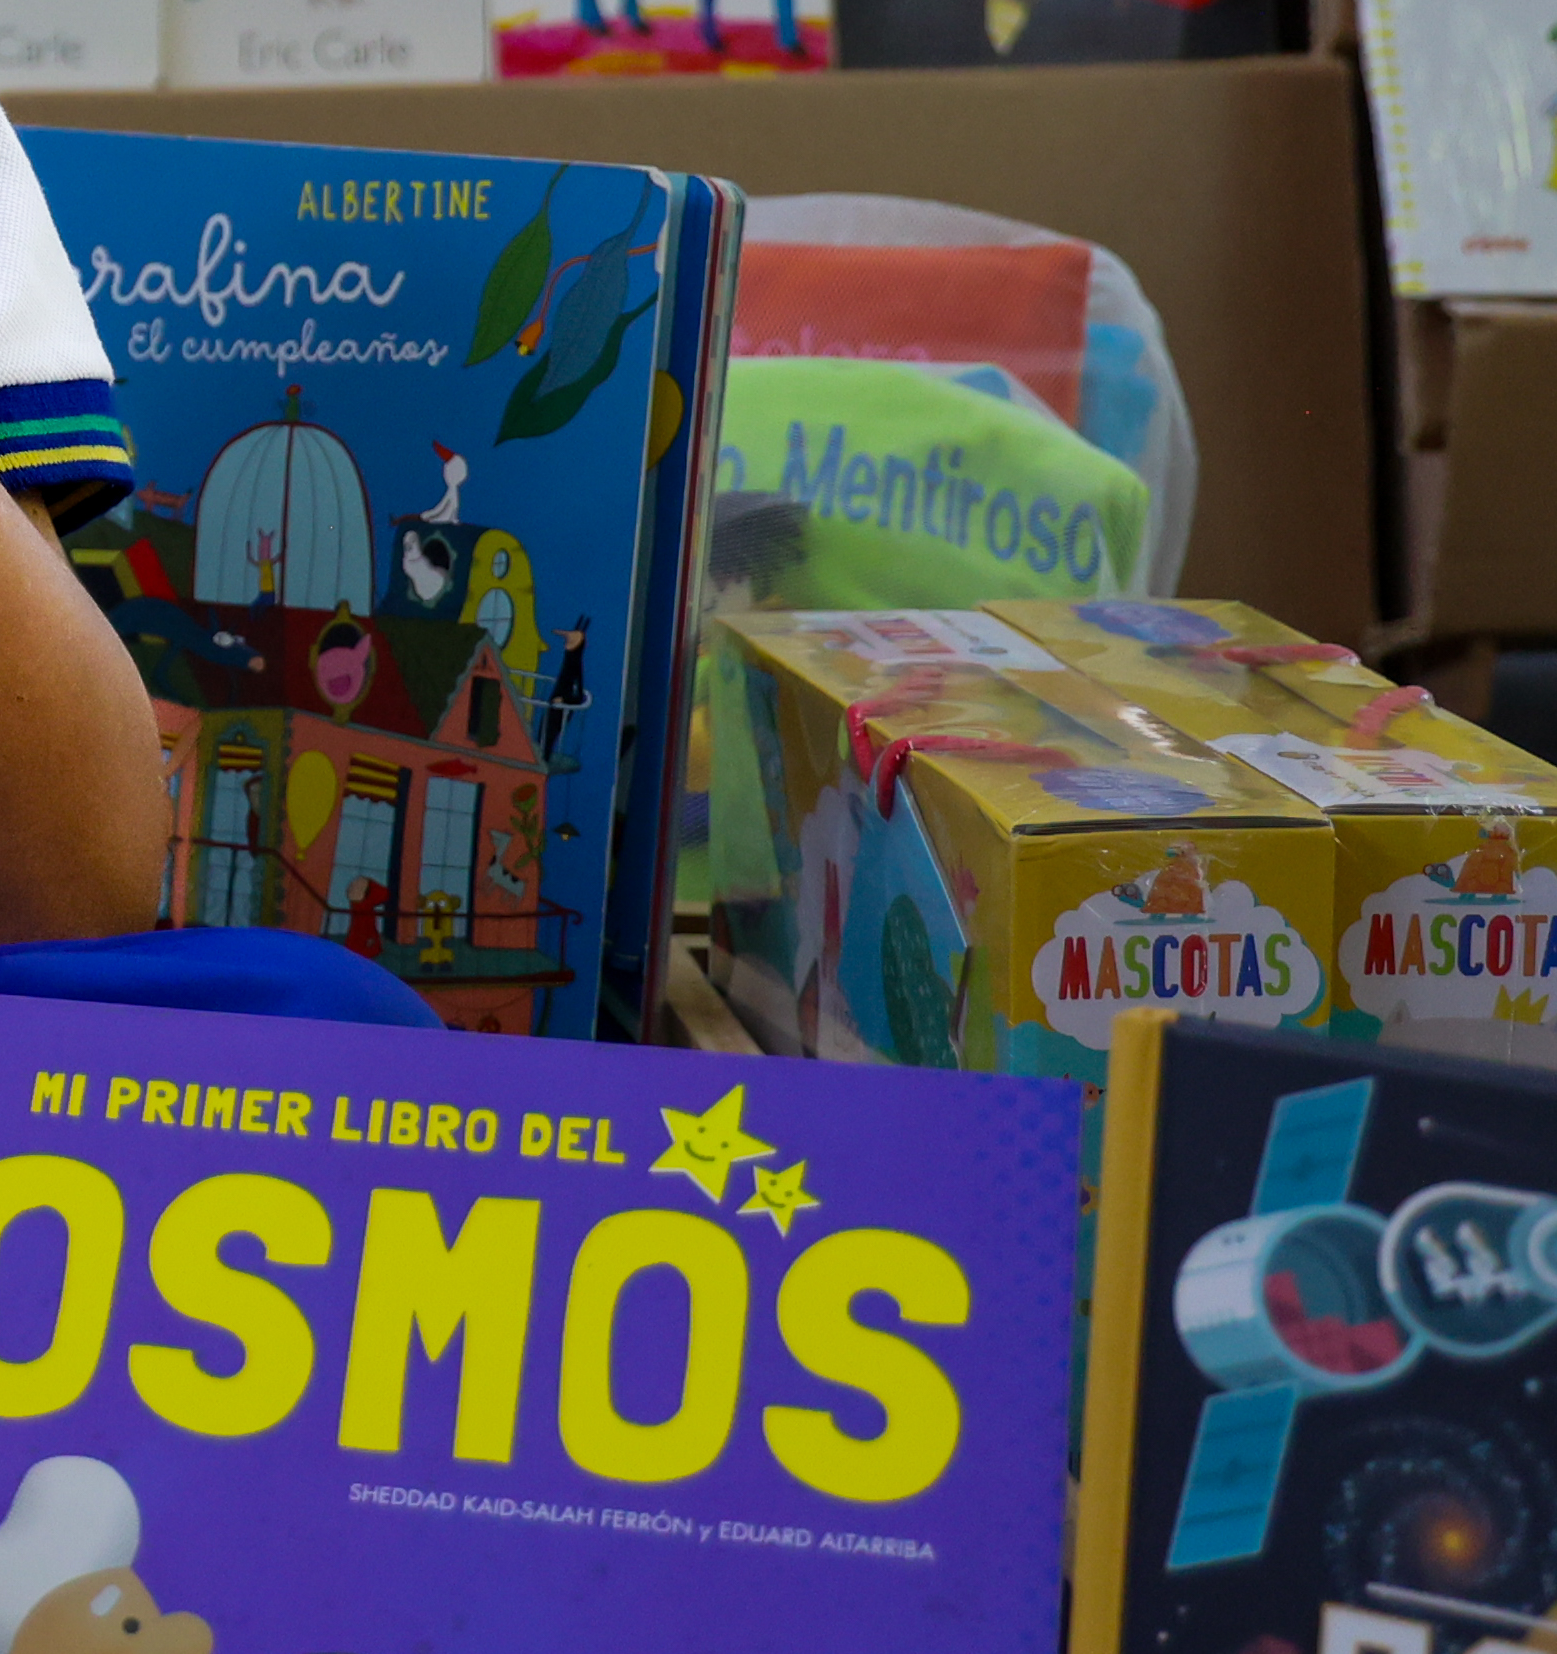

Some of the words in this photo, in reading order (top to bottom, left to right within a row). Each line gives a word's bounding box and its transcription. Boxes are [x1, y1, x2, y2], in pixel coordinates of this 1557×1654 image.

[237, 30, 302, 70] Eric
[312, 28, 414, 70] Carle
[296, 180, 493, 222] ALBERTINE
[127, 317, 172, 362] El
[182, 317, 449, 379] cumpleaños
[782, 420, 1101, 582] Mentiroso
[1058, 933, 1292, 1001] MASCOTAS
[1364, 913, 1557, 977] MASCOTA
[31, 1071, 86, 1122] MI
[105, 1076, 312, 1139] PRIMER
[332, 1095, 499, 1154] LIBRO
[519, 1112, 627, 1167] DEL
[349, 1482, 456, 1511] SHEDDAD
[462, 1494, 594, 1526] KAID-SALAH
[601, 1506, 693, 1537] FERRÓN
[699, 1525, 710, 1544] y
[719, 1520, 813, 1549] EDUARD
[819, 1532, 935, 1561] ALTARRIBA
